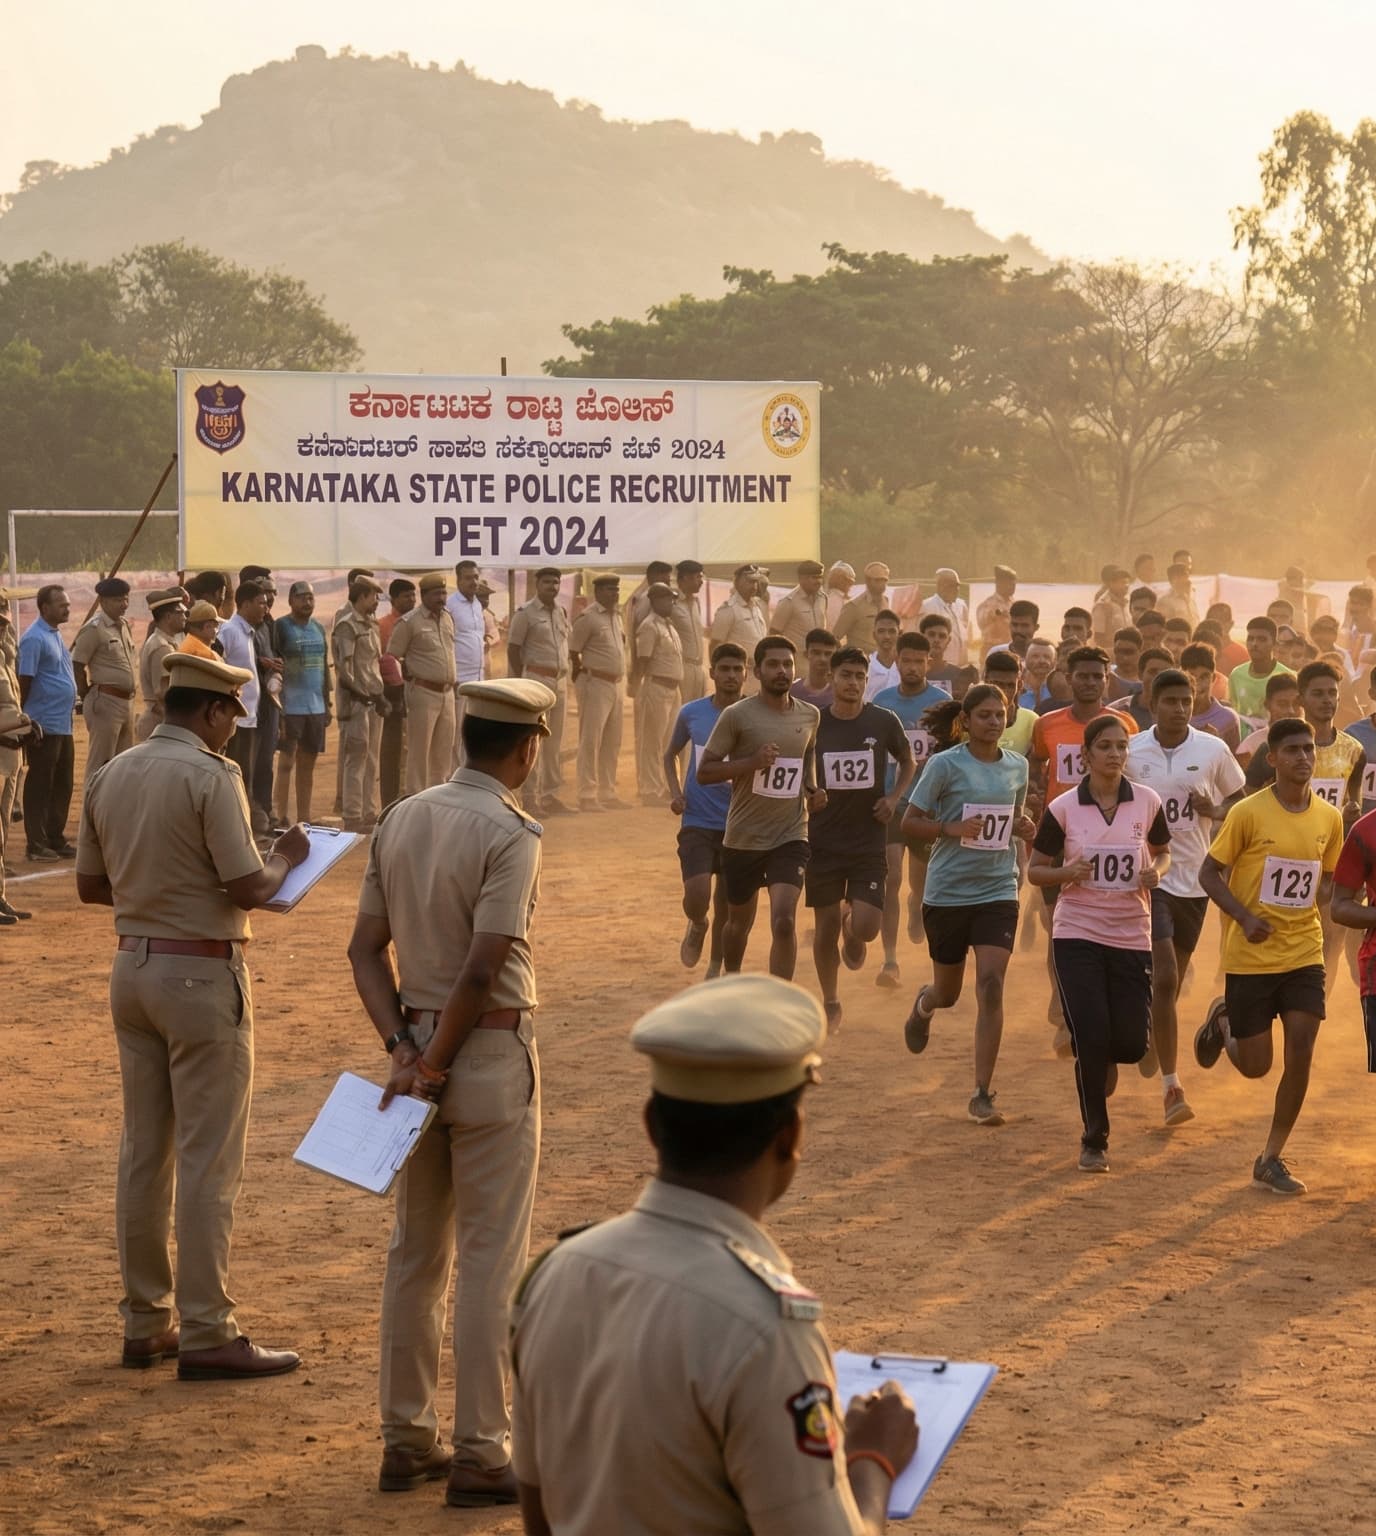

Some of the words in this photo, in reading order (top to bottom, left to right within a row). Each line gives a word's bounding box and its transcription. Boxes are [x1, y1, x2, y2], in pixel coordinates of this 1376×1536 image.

[671, 439, 726, 460] 2024
[221, 471, 401, 503] KARNATAKA
[409, 473, 495, 504] STATE
[505, 474, 600, 504] POLICE
[610, 474, 792, 503] RECRUITMENT
[434, 517, 508, 556] PET
[519, 515, 609, 556] 2024
[760, 766, 799, 791] 187
[831, 758, 869, 782] 132
[1063, 753, 1087, 776] 13
[1165, 793, 1195, 823] 84
[973, 813, 1010, 841] 07
[1090, 853, 1135, 882] 103
[1270, 867, 1313, 899] 123
